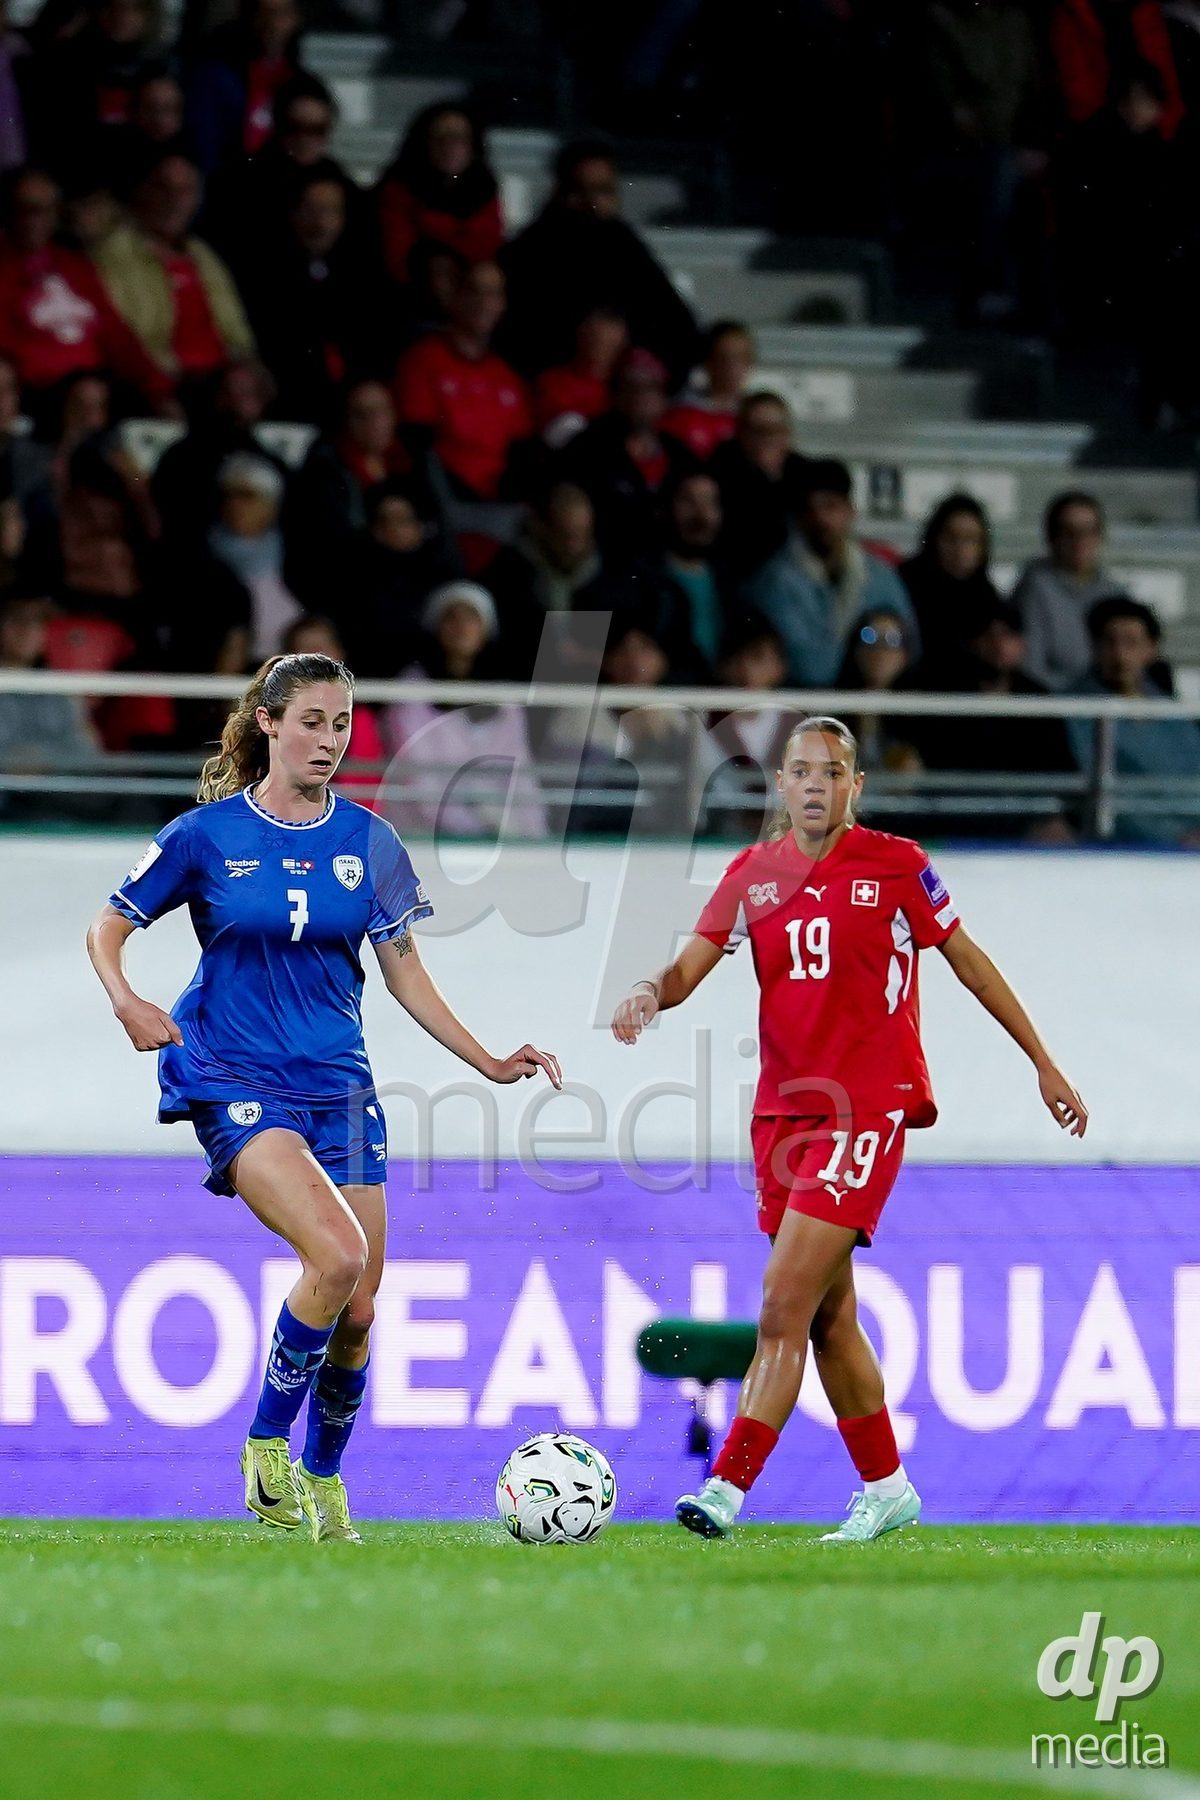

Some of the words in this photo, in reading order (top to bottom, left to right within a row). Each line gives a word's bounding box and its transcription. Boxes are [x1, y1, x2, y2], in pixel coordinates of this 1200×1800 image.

[224, 859, 260, 867] Reebok
[286, 889, 310, 941] 7
[784, 916, 831, 980] 19
[816, 1130, 880, 1189] 19
[0, 1253, 728, 1428] ROEAN
